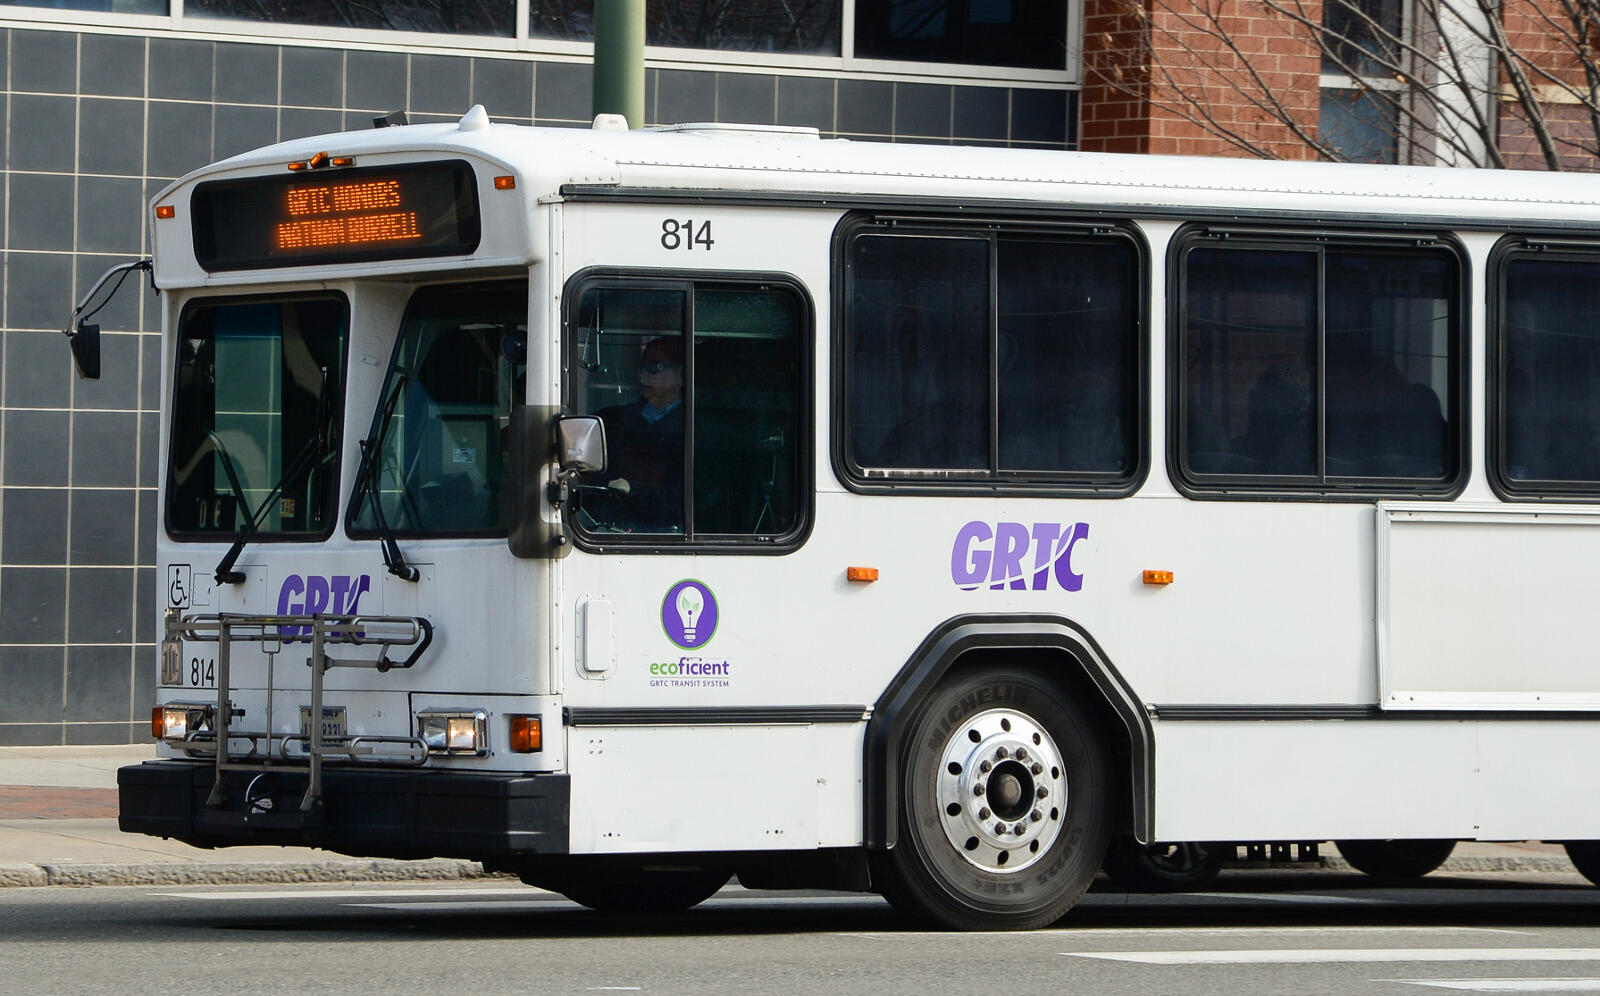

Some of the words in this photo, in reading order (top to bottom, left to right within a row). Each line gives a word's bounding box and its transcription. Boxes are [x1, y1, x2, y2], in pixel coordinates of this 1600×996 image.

[288, 187, 331, 215] GRTC
[333, 181, 401, 211] HONORS
[278, 219, 346, 248] NATHAN
[660, 218, 715, 251] 814
[950, 520, 1090, 592] GRTC
[190, 657, 215, 688] 814
[649, 656, 730, 675] ecoficient
